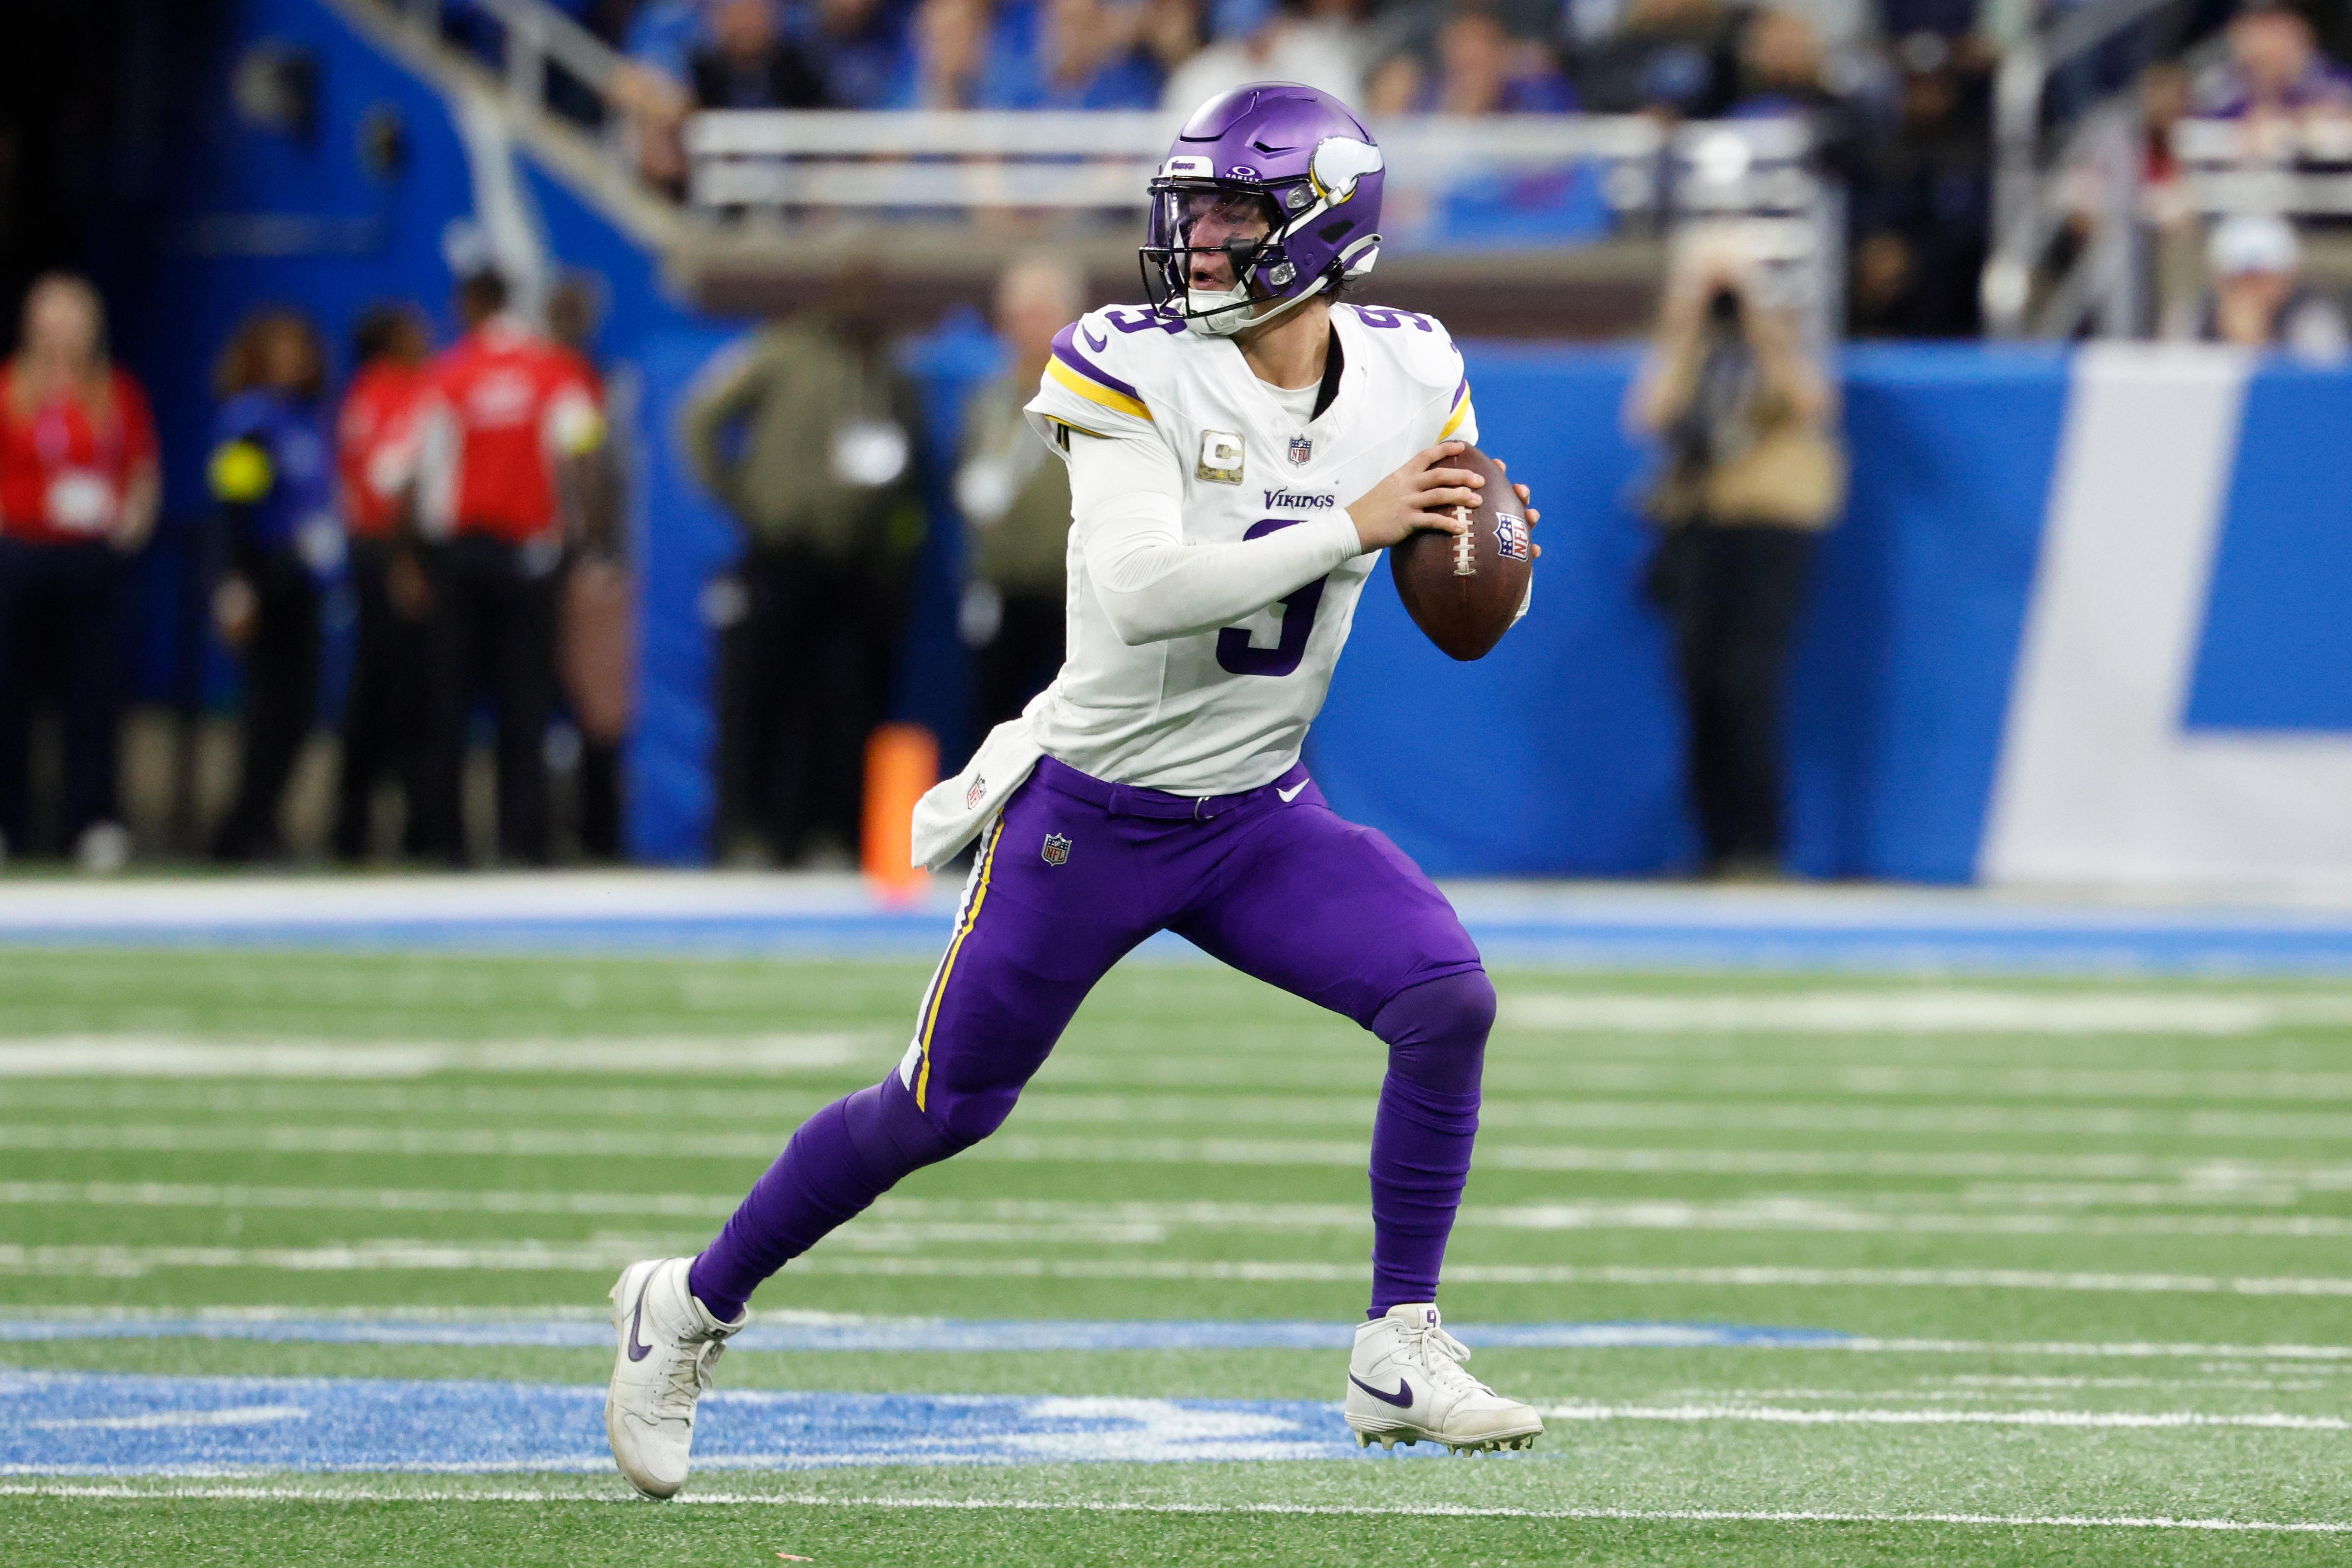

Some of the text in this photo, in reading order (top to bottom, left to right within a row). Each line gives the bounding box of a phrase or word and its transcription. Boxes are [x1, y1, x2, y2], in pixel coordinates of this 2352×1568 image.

[1225, 173, 1260, 182] OAKLEY
[1203, 434, 1243, 470] C
[1292, 448, 1309, 461] NFL
[1264, 486, 1335, 511] VIKINGS
[1514, 523, 1527, 555] NFL
[1046, 846, 1063, 860] NFL
[1427, 1309, 1436, 1328] 9
